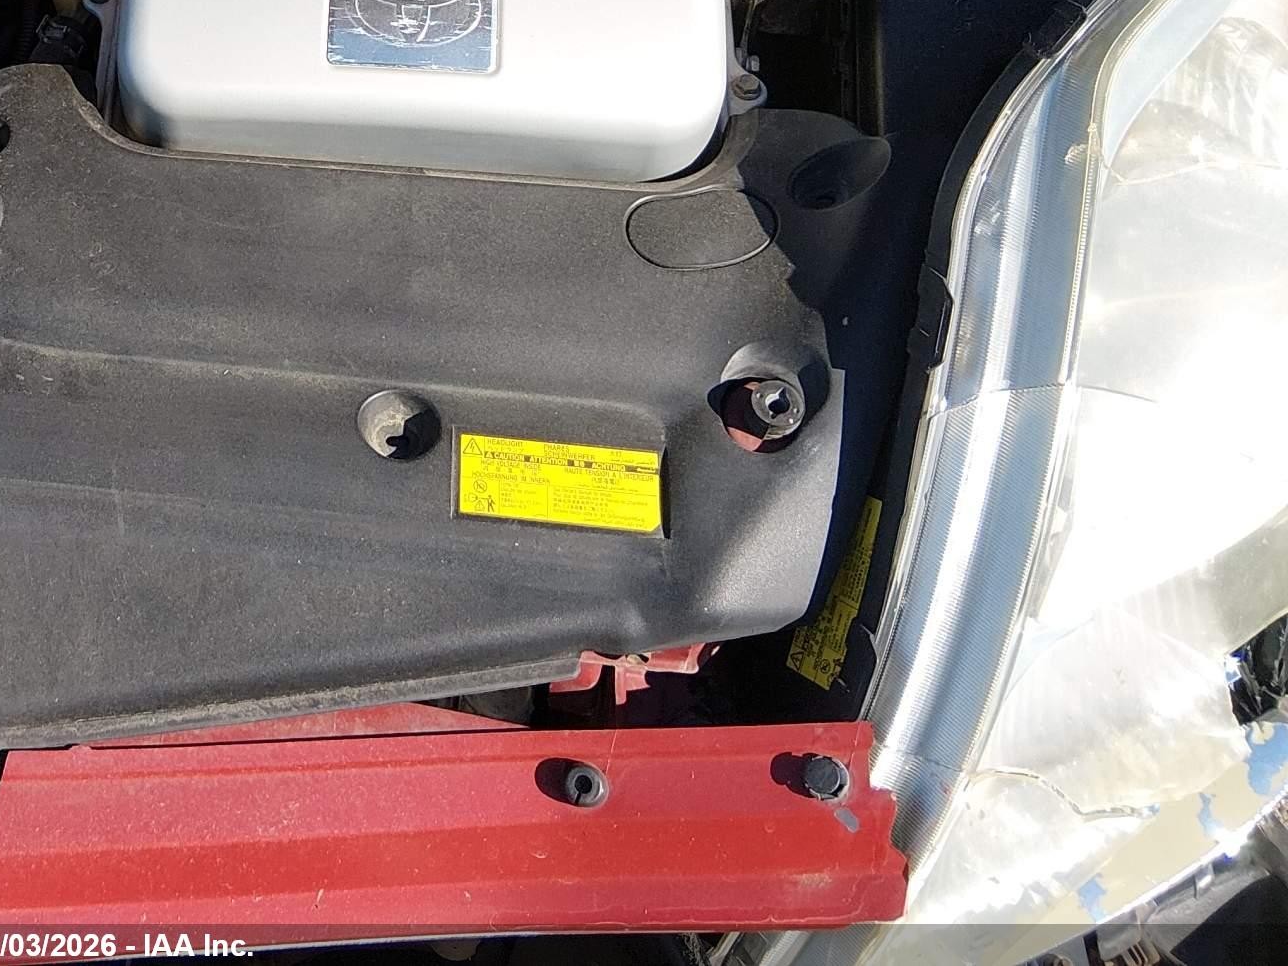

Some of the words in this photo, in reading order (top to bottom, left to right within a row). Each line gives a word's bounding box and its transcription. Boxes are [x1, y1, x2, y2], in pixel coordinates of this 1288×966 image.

[487, 438, 522, 447] HEADLIGHT
[544, 444, 569, 452] PHARES
[494, 452, 523, 460] CAUTION
[530, 455, 566, 465] ATTENTION
[591, 462, 624, 471] ACHTUNG
